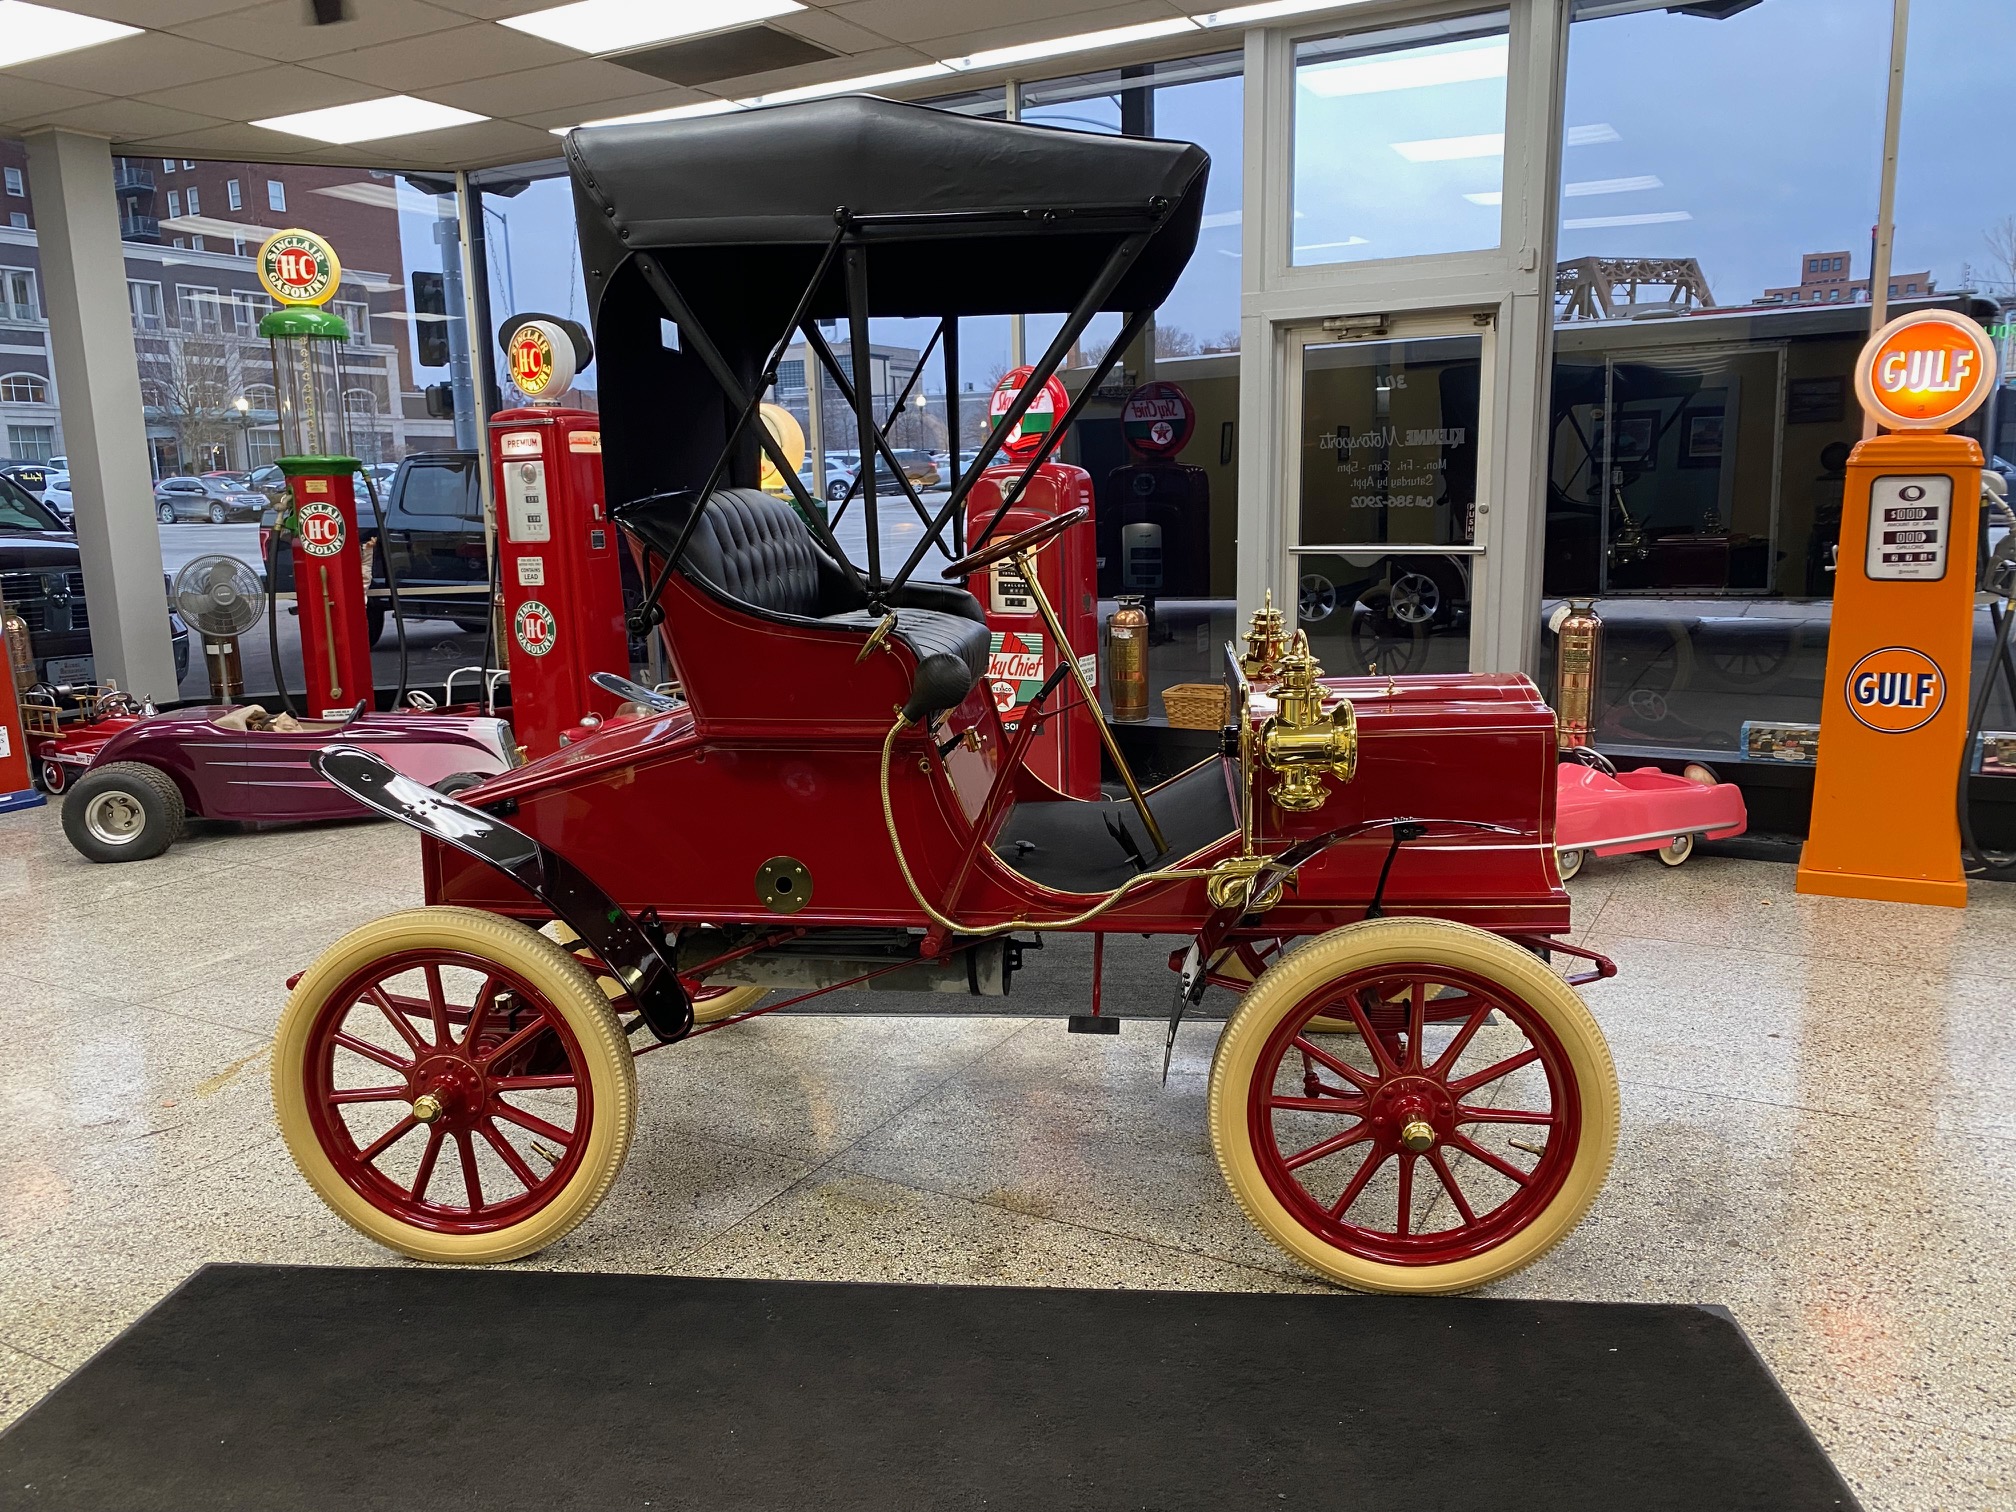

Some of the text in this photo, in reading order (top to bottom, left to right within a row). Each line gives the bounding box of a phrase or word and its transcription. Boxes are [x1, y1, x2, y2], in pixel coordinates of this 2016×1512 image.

[267, 238, 325, 262] SINCLAIR
[268, 272, 328, 298] GASOLINE
[512, 330, 549, 355] SINCLAIR
[513, 364, 551, 391] GASOLINE
[1878, 350, 1974, 393] GULF
[507, 438, 538, 448] PREMIUM
[299, 505, 342, 525] SINCLAIR
[300, 534, 345, 554] GASOLINE
[517, 603, 553, 626] SINCLAIR
[518, 632, 554, 654] GASOLINE
[1008, 654, 1043, 677] Chief
[1853, 672, 1937, 709] GULF
